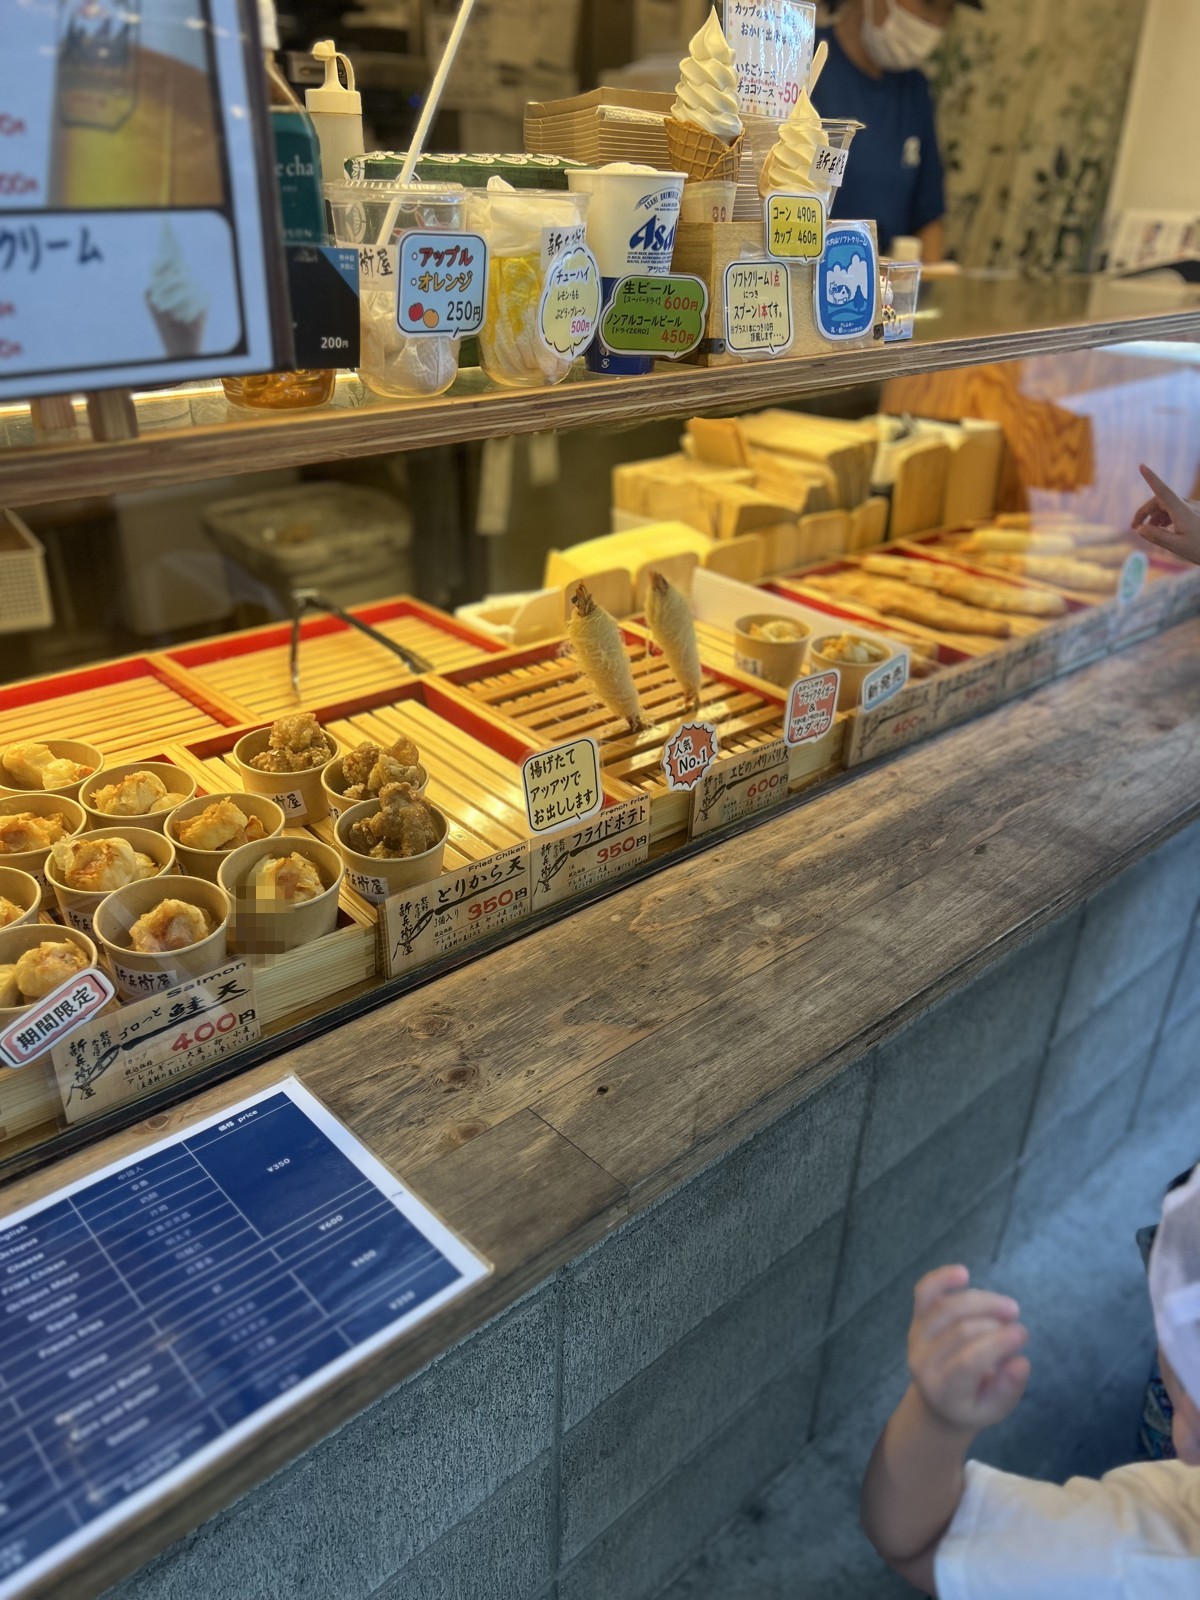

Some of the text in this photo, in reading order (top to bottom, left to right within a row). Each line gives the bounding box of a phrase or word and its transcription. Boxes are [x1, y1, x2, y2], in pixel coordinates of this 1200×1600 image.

[737, 80, 775, 98] チョコソース
[286, 155, 315, 176] cha
[773, 206, 816, 223] コーン 490円
[773, 228, 817, 245] カップ 460円
[418, 244, 474, 268] アップル
[417, 269, 474, 294] オレンジ
[556, 266, 590, 285] チューハイ
[622, 281, 676, 296] 生ビール
[743, 289, 759, 299] につき
[446, 300, 481, 322] 250円
[664, 296, 699, 311] 600円
[570, 319, 590, 334] 500円
[606, 313, 683, 328] ノンアルコールビール
[320, 336, 349, 350] 200円
[661, 329, 695, 344] 450円
[808, 703, 816, 712] &
[795, 717, 829, 738] カダイフ
[673, 738, 693, 758] 人気
[529, 748, 577, 780] 揚げたて
[678, 748, 707, 775] No.1
[747, 773, 789, 798] 600円
[533, 789, 594, 826] お出しします
[600, 794, 649, 818] French fries
[572, 805, 646, 848] フライドポテト
[468, 844, 526, 873] Fried Chiken
[596, 834, 647, 864] 350円
[437, 855, 526, 904] とりから天
[467, 887, 528, 921] 350円
[166, 961, 247, 999] Salmon
[16, 983, 97, 1051] 期間限定
[171, 1008, 257, 1053] 400円
[237, 1109, 259, 1124] price
[266, 1157, 291, 1174] ¥350
[0, 1224, 28, 1242] nglish
[318, 1214, 344, 1232] ¥600
